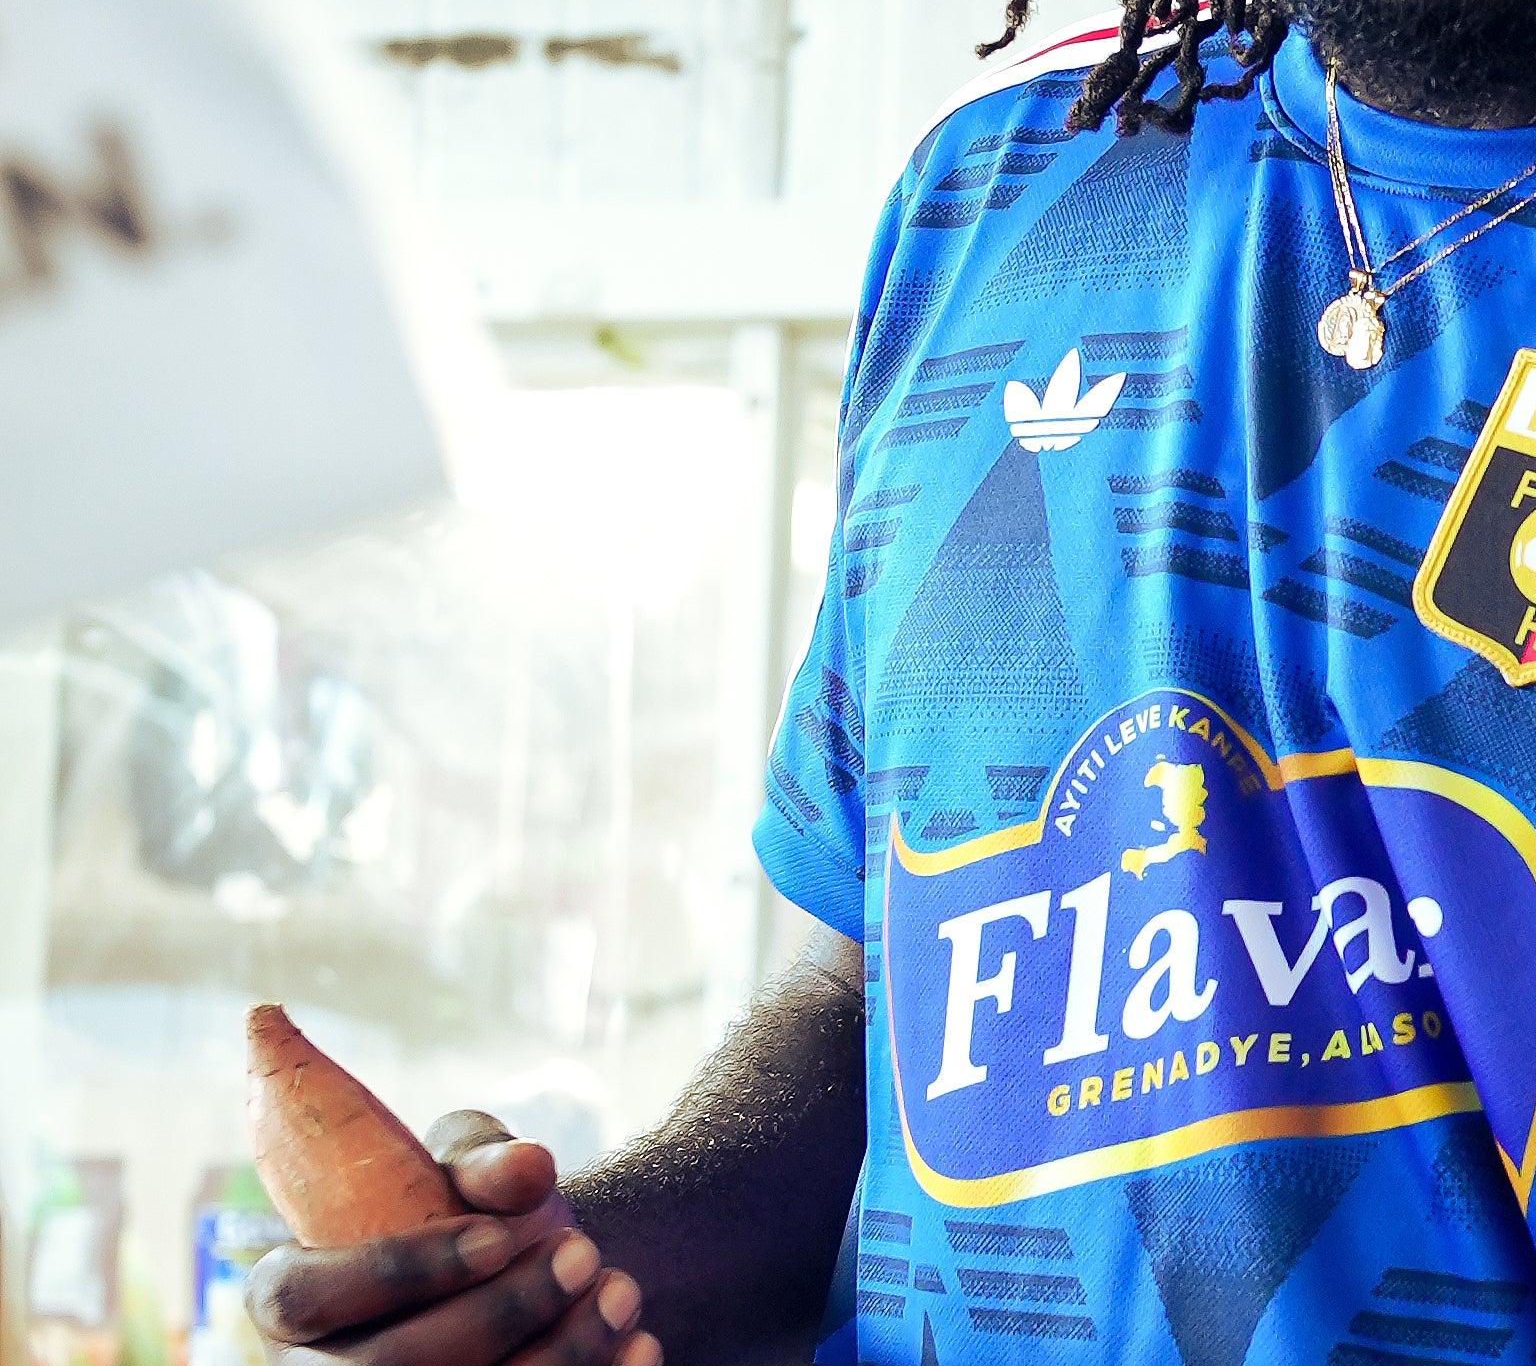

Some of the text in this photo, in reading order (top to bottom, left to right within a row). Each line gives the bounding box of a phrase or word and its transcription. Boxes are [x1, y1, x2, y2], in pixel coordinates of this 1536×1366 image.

[1054, 704, 1262, 838] AYITI LEVE KANPE
